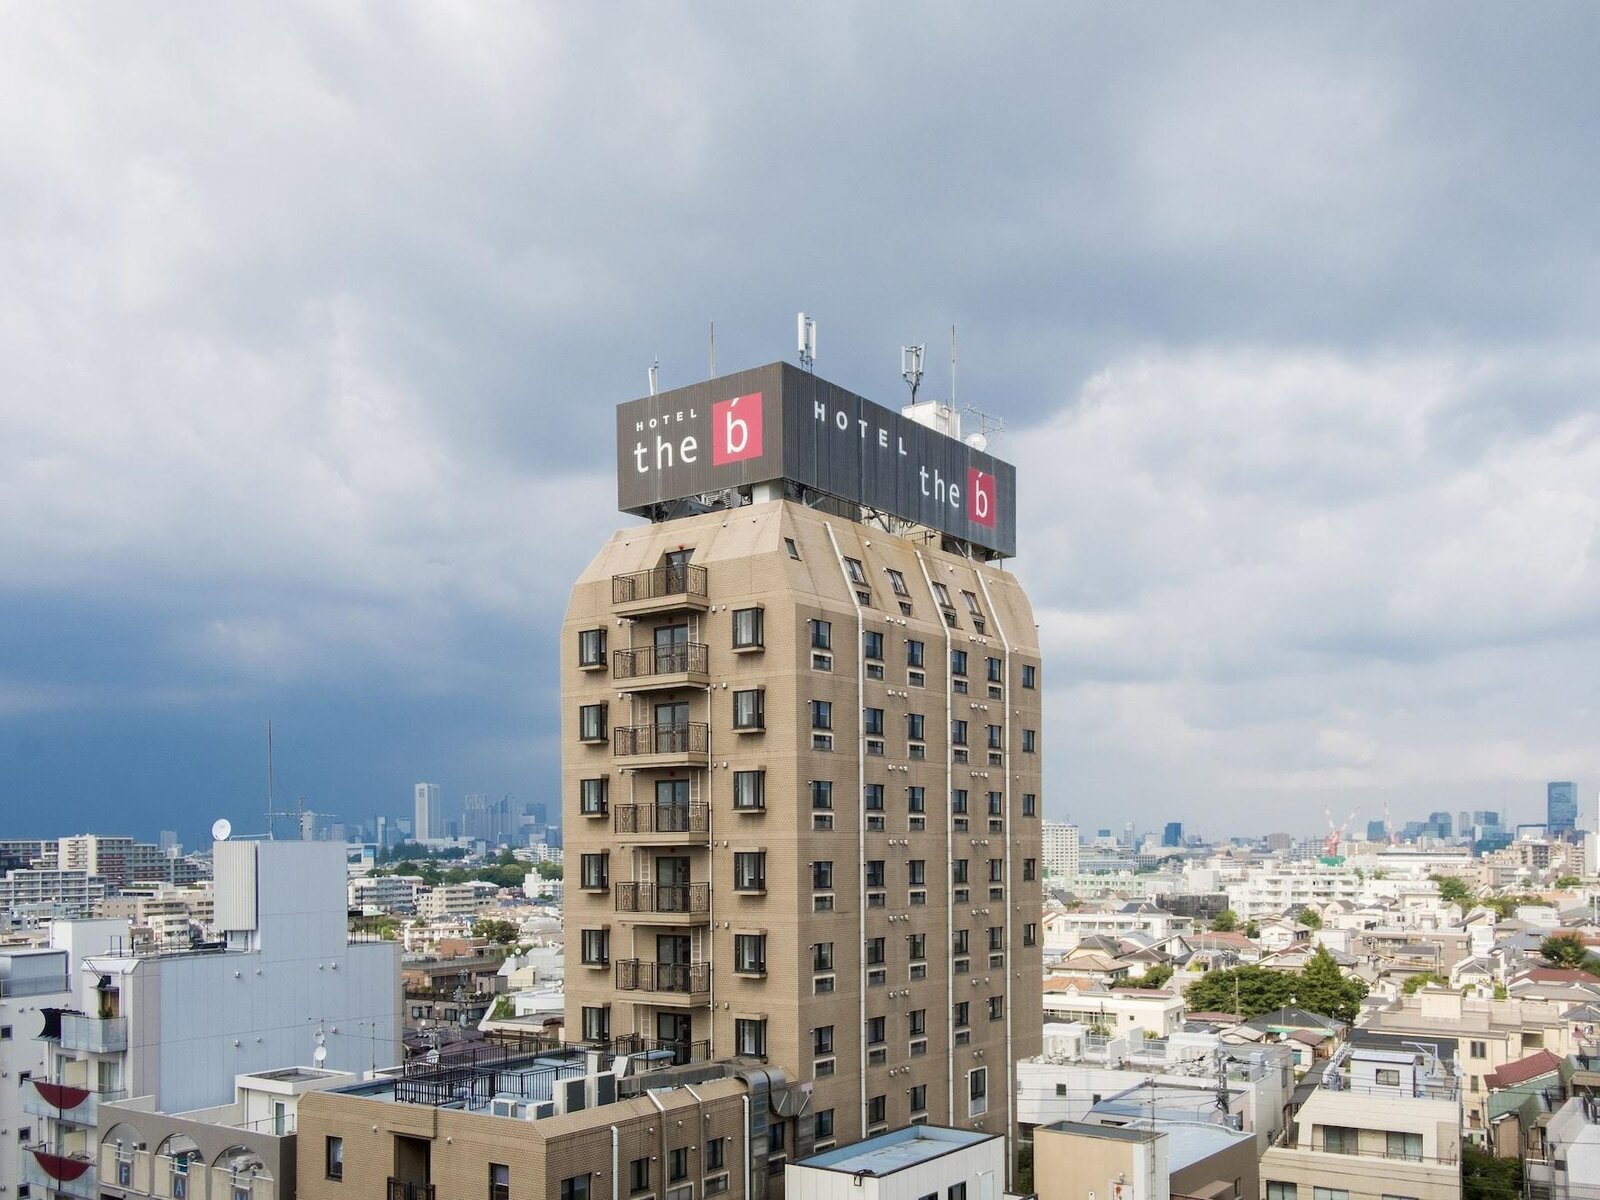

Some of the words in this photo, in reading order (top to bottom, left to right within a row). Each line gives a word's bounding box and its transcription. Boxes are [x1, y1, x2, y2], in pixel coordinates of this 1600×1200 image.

[635, 408, 697, 432] HOTEL
[633, 435, 698, 474] the
[813, 400, 908, 456] HOTEL
[919, 465, 960, 509] the
